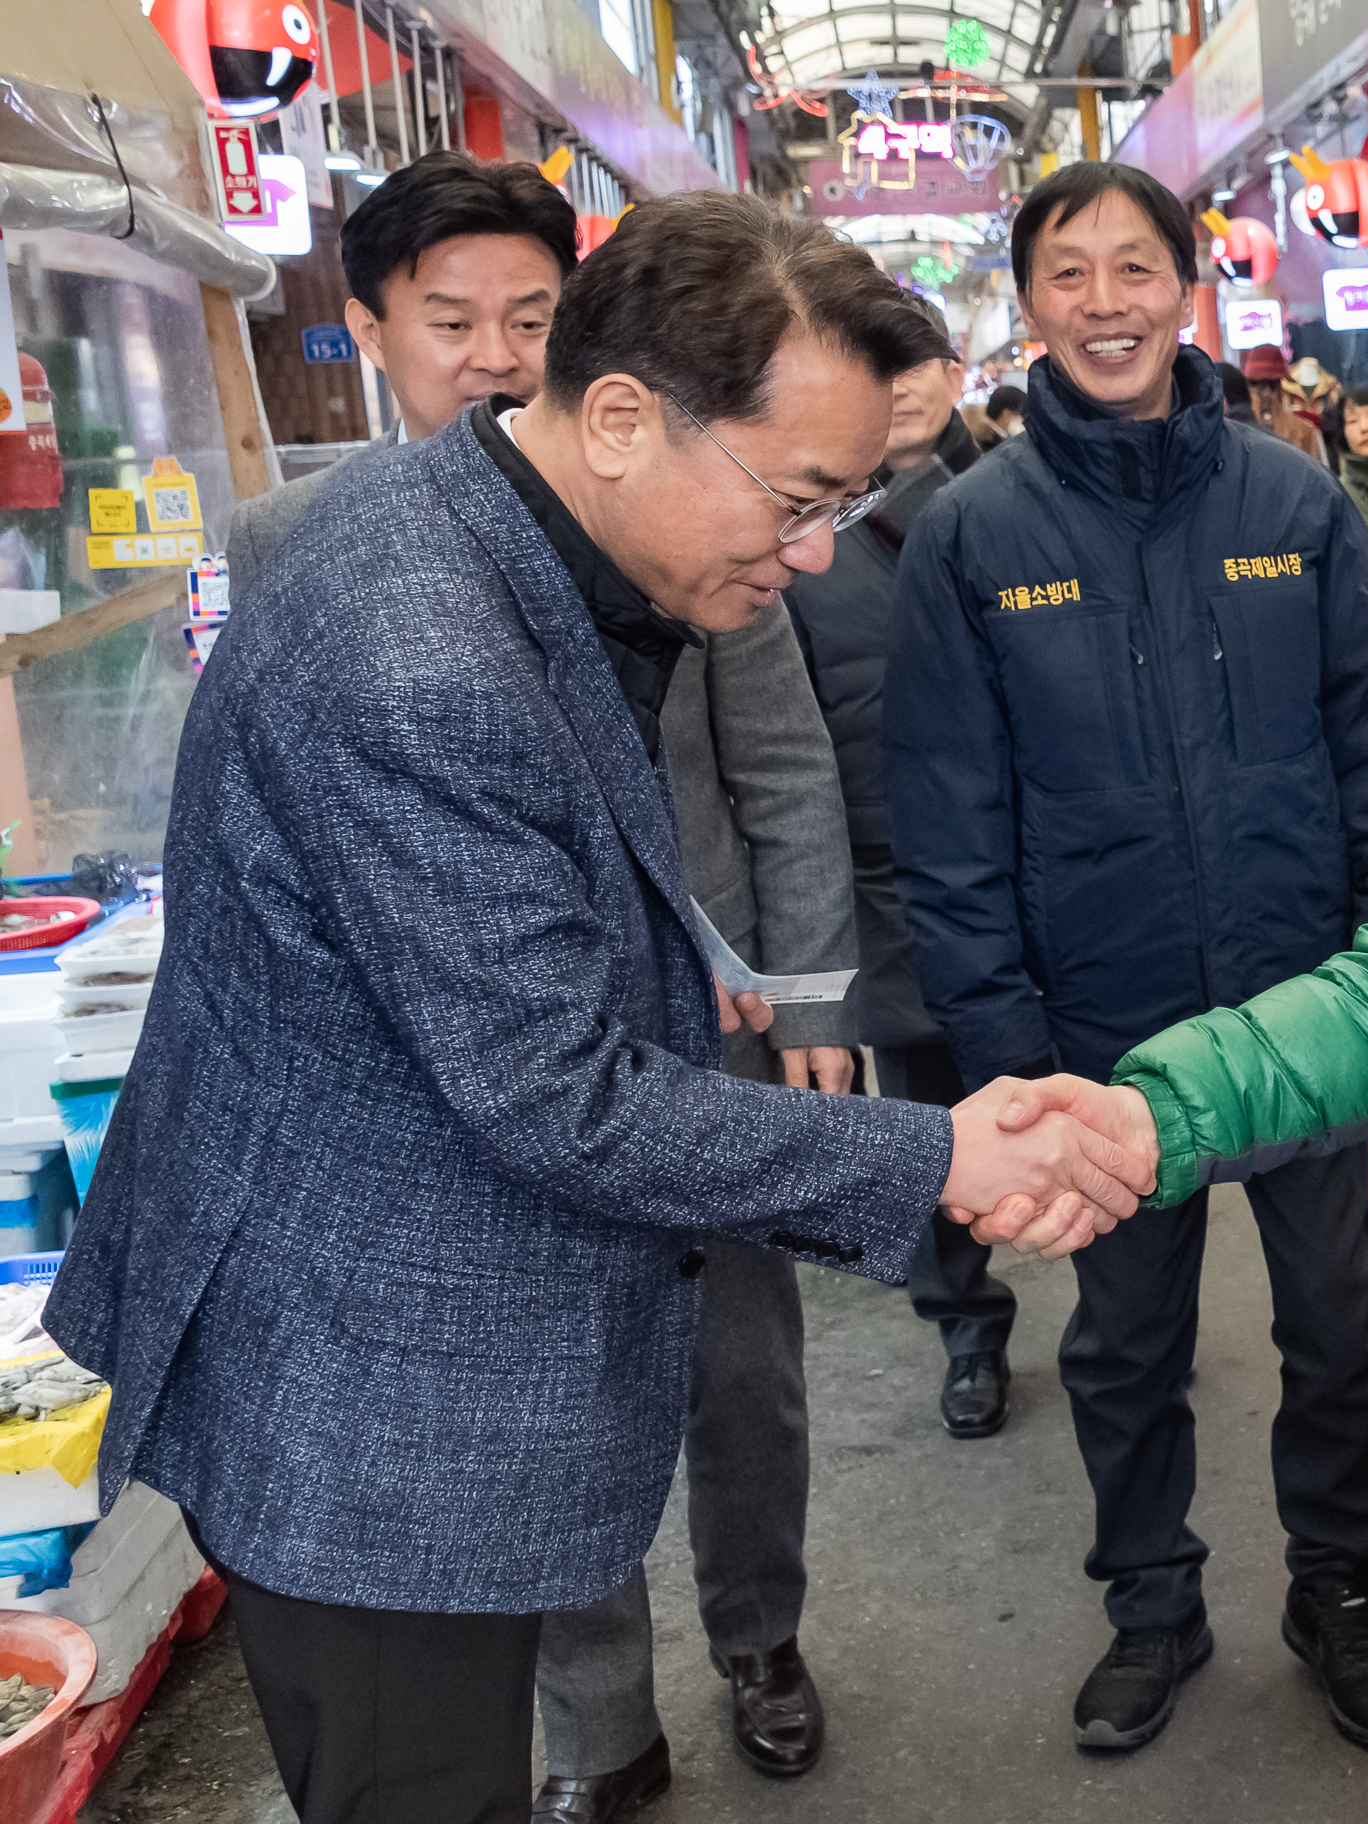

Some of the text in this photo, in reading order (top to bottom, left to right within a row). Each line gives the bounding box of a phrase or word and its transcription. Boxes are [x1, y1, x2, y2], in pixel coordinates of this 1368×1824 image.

[224, 175, 257, 189] 소화기
[1223, 552, 1302, 582] 중곡제일시장
[998, 578, 1081, 612] 자율소방대
